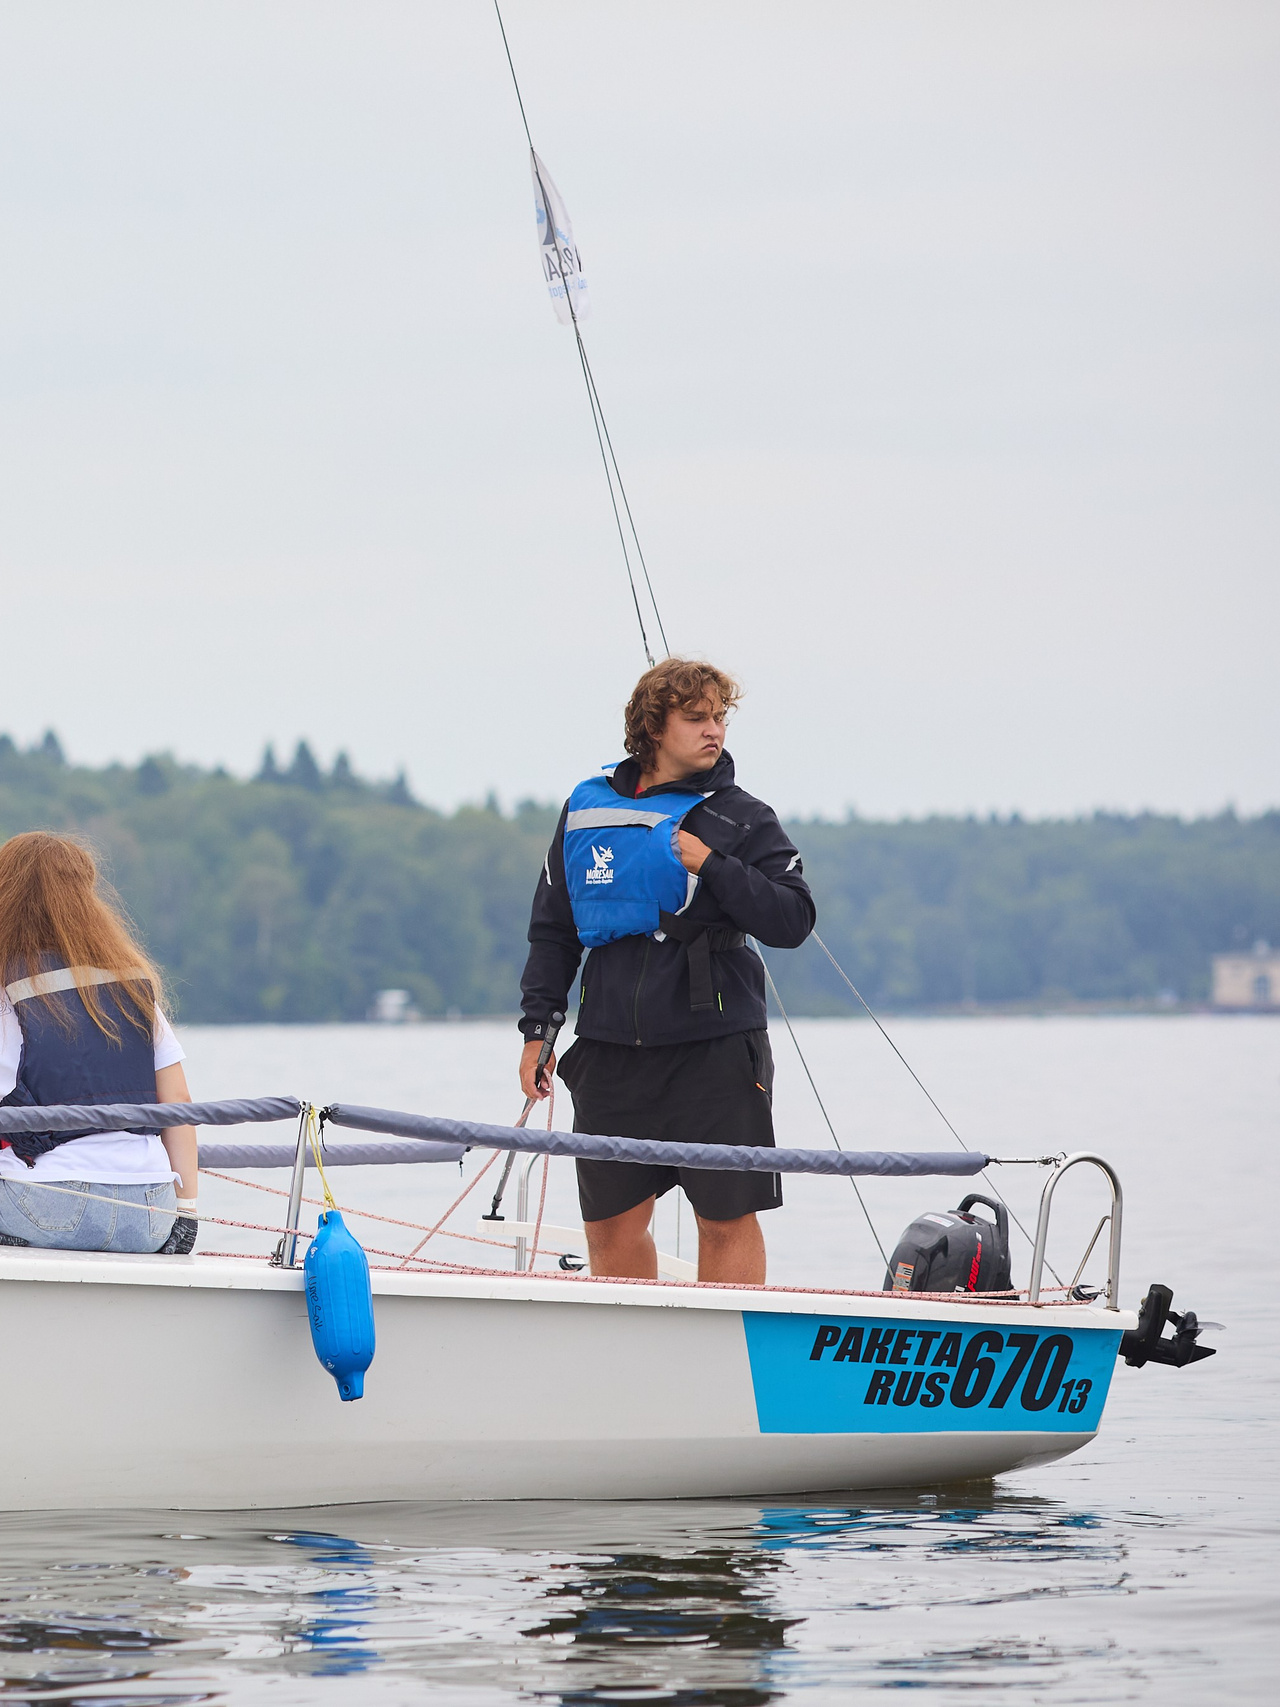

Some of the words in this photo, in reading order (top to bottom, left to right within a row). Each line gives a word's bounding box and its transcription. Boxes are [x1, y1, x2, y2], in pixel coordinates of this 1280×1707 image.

[863, 1369, 950, 1408] RUS
[949, 1330, 1074, 1412] 670
[1057, 1378, 1093, 1414] 13
